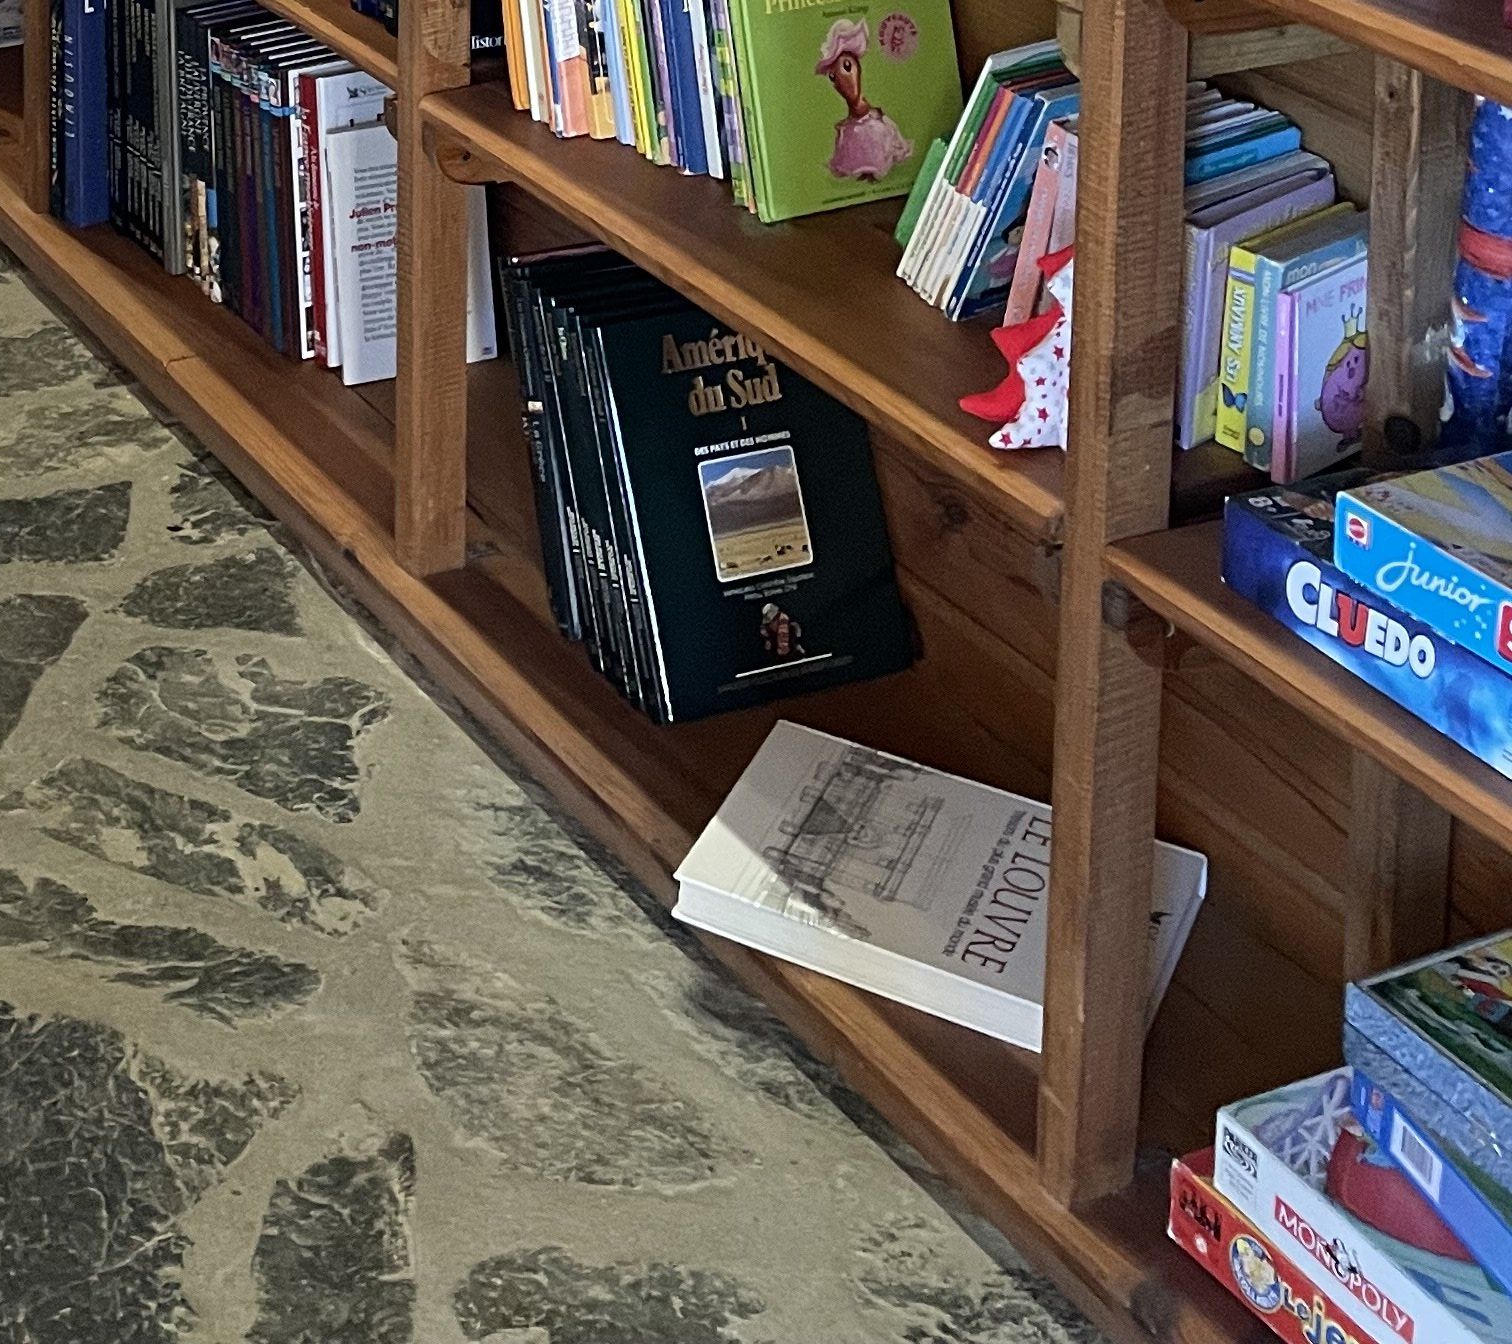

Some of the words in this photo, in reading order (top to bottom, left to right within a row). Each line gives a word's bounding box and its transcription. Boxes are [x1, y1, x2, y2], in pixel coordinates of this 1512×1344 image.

[660, 328, 766, 374] Amériq
[1229, 286, 1245, 354] ANIMAUX
[688, 375, 728, 417] du
[726, 362, 783, 409] Sud
[1225, 356, 1240, 383] LES
[1375, 542, 1495, 612] junior
[1286, 560, 1436, 679] CLUEDO
[1021, 816, 1052, 847] LE
[960, 851, 1051, 974] LOUVRE
[1278, 1204, 1408, 1333] MONOPOLY
